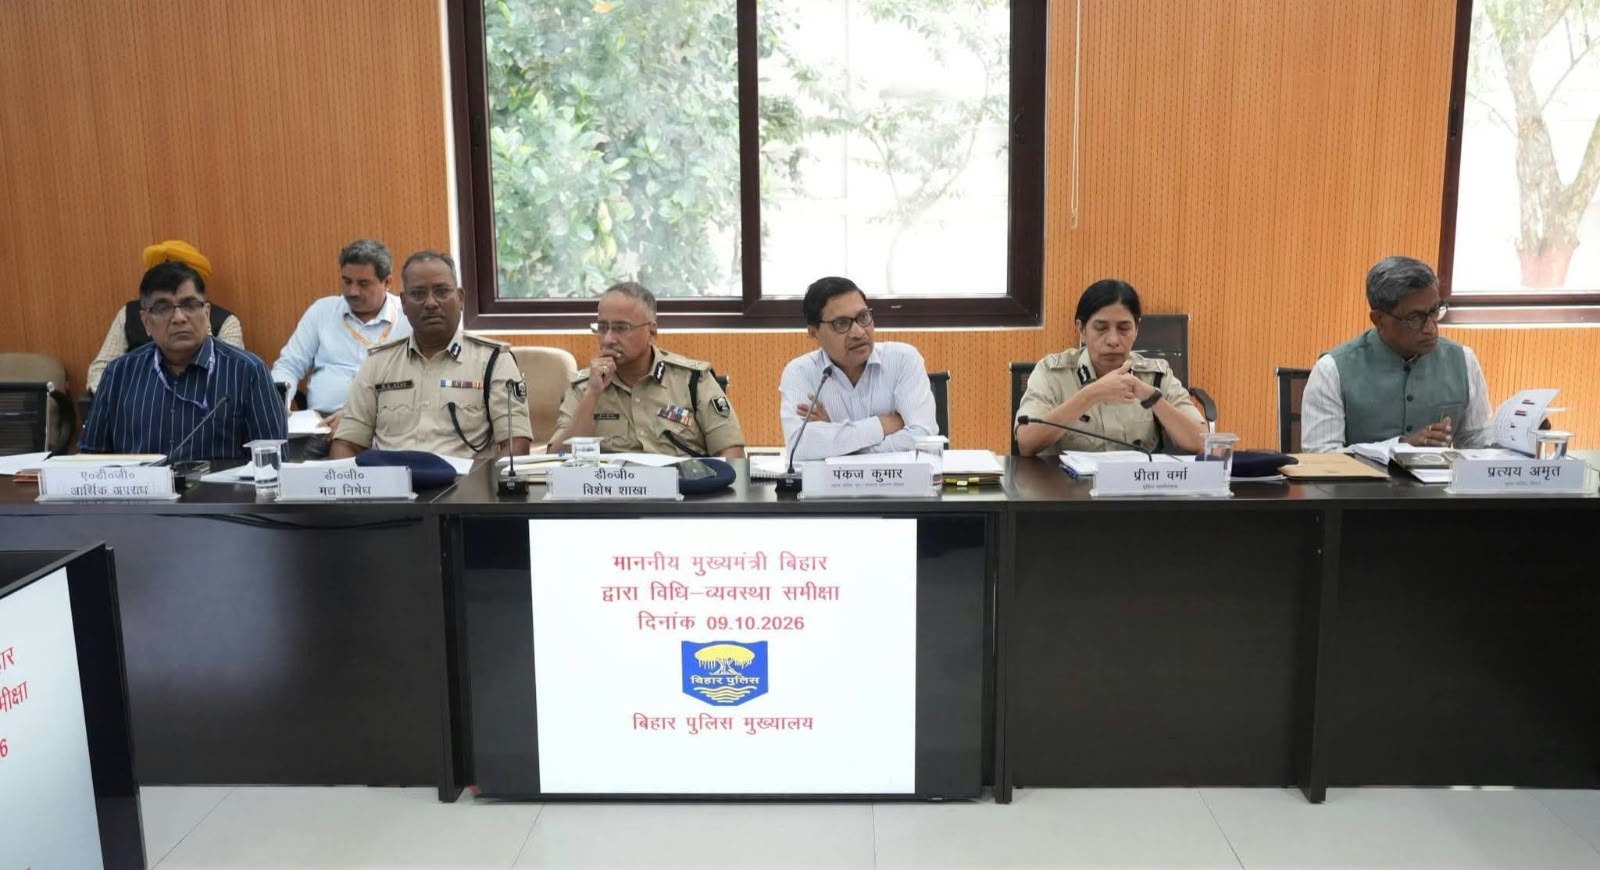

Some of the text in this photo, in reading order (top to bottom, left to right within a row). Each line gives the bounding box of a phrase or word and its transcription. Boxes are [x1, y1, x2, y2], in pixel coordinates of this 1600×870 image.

[833, 466, 903, 482] पंकज कुमार
[1133, 466, 1188, 481] प्रीता वर्मा
[1487, 465, 1561, 480] प्रत्यय अमृत
[70, 481, 148, 496] आर्थिक अपराध
[319, 482, 371, 496] मद्य निषेध
[583, 482, 647, 496] विशेष शाखा
[612, 550, 828, 576] माननीय मुख्यमंत्री बिहार
[601, 586, 640, 602] द्वारा
[781, 581, 840, 601] समीक्षा
[636, 610, 805, 630] दिनांक 09.10.2026
[690, 674, 760, 686] बिहार पुलिस
[632, 712, 814, 735] बिहार पुलिस मुख्यालय
